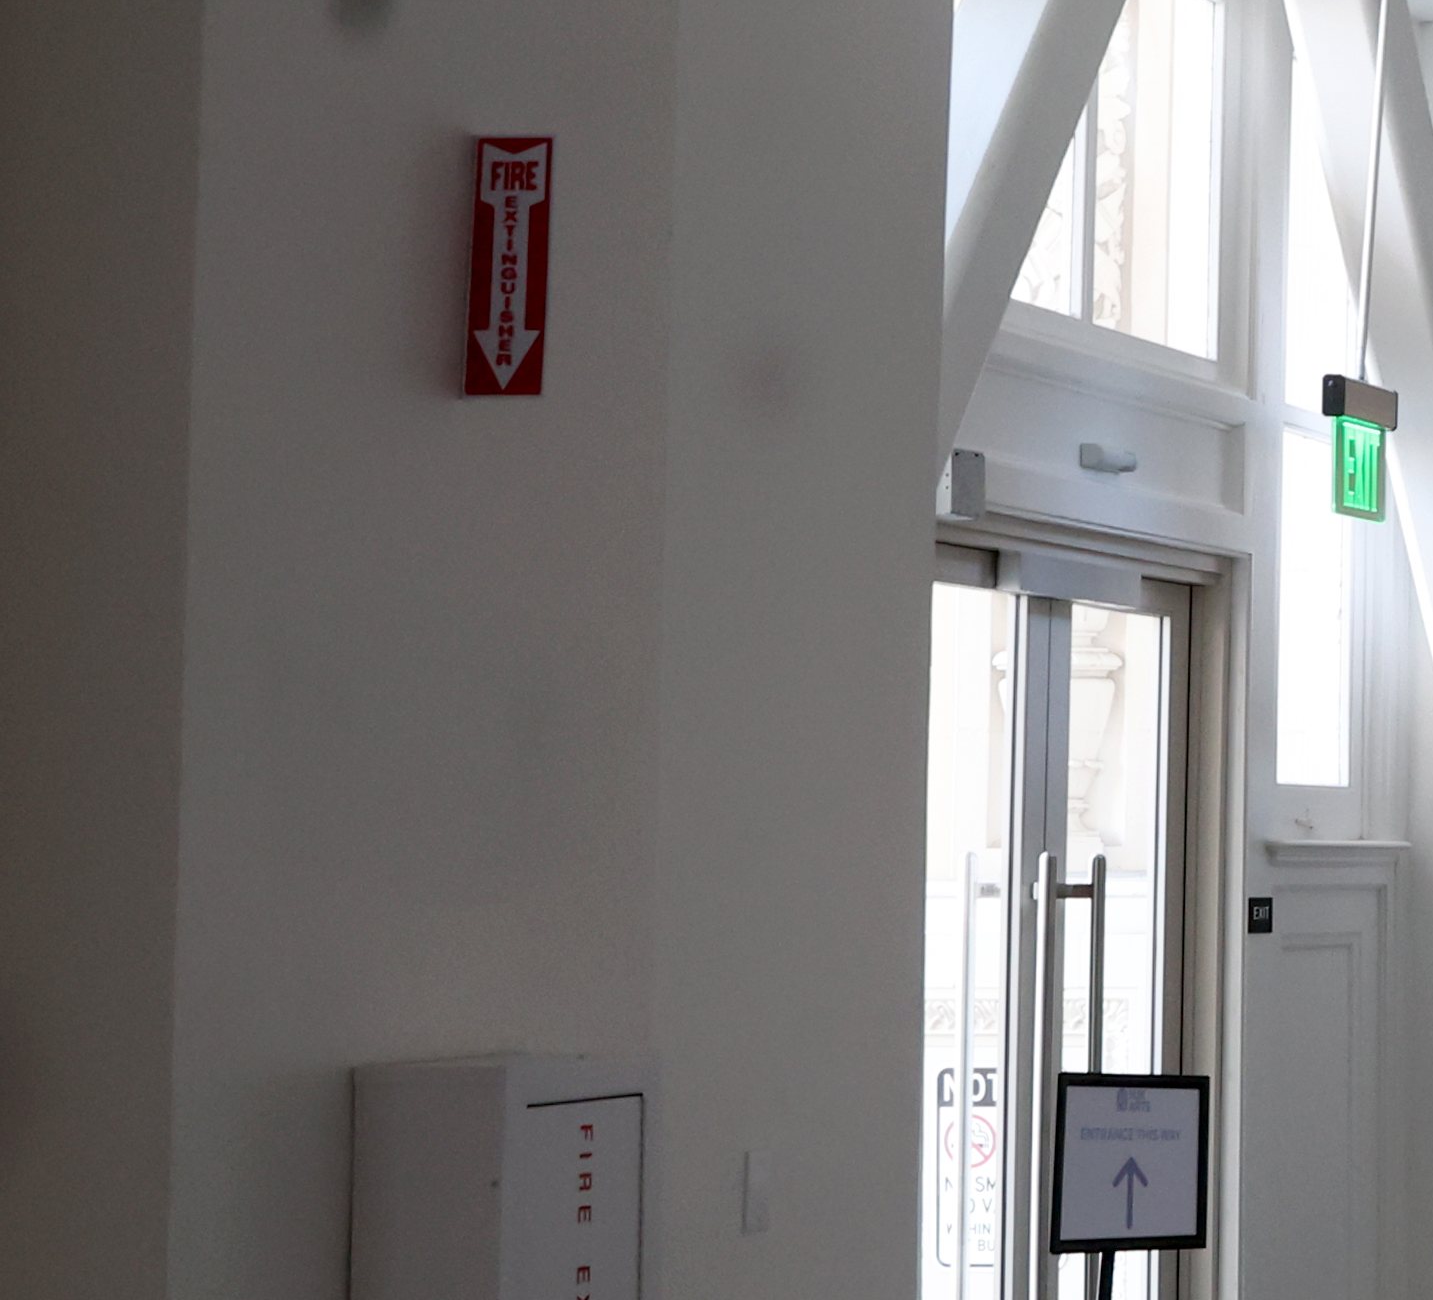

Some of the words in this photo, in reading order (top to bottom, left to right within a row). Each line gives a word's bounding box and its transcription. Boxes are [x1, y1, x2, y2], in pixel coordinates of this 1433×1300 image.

[490, 161, 539, 191] FIRE
[496, 196, 518, 366] EXTINGUISHER
[1080, 1127, 1133, 1140] ENTRANCE
[1161, 1130, 1181, 1141] WAY
[577, 1124, 594, 1225] FIRE
